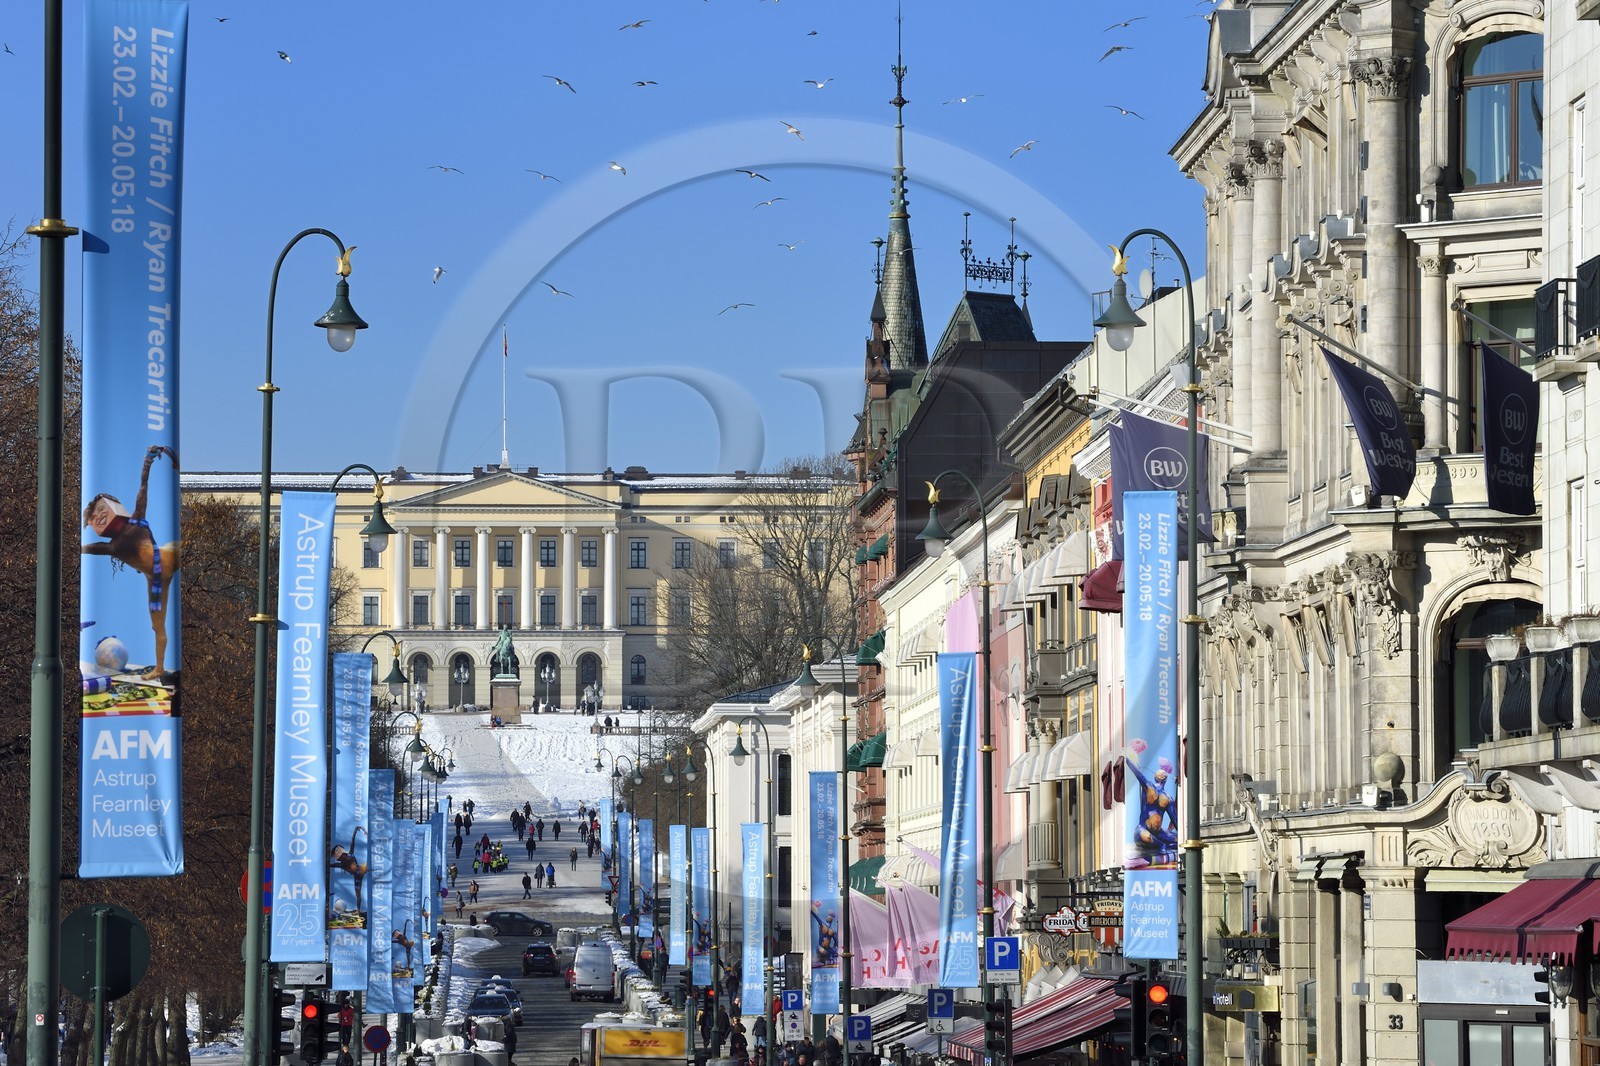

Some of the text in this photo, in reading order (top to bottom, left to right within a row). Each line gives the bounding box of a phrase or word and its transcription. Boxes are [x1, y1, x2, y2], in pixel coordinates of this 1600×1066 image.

[145, 26, 174, 431] Lizzie Fitch / Ryan Trecartin
[1371, 398, 1393, 419] BW
[1505, 408, 1525, 431] BW
[1501, 446, 1524, 468] Best
[1150, 459, 1183, 477] BW
[1157, 512, 1171, 555] Lizzie
[1157, 559, 1171, 598] Fitch
[1156, 613, 1171, 651] Ryan
[284, 512, 325, 866] Astrup Fearnley Museet
[1158, 656, 1171, 724] Trecartin
[948, 667, 969, 737] Astrup
[91, 730, 171, 760] AFM
[354, 741, 365, 768] Ryan
[94, 769, 156, 790] Astrup
[92, 795, 171, 816] Fearnley
[354, 772, 365, 822] Trecartin
[92, 819, 164, 838] Museet
[951, 839, 969, 919] Museet
[1130, 881, 1172, 897] AFM
[277, 883, 319, 900] AFM
[746, 831, 760, 976] Astrup Fearnley Museet
[1131, 902, 1164, 912] Astrup
[277, 903, 320, 937] 25
[1091, 917, 1117, 926] AMERICAN
[1130, 915, 1172, 927] Fearnley
[333, 934, 363, 946] AFM
[373, 905, 388, 964] Museet
[944, 932, 973, 943] AFM
[1130, 927, 1168, 939] Museet
[994, 941, 1010, 966] P
[369, 972, 390, 982] AFM
[814, 974, 836, 982] AFM
[787, 993, 798, 1008] P
[933, 993, 946, 1014] P
[853, 1019, 866, 1038] P
[1388, 1014, 1403, 1030] 33
[628, 1039, 660, 1047] DHL
